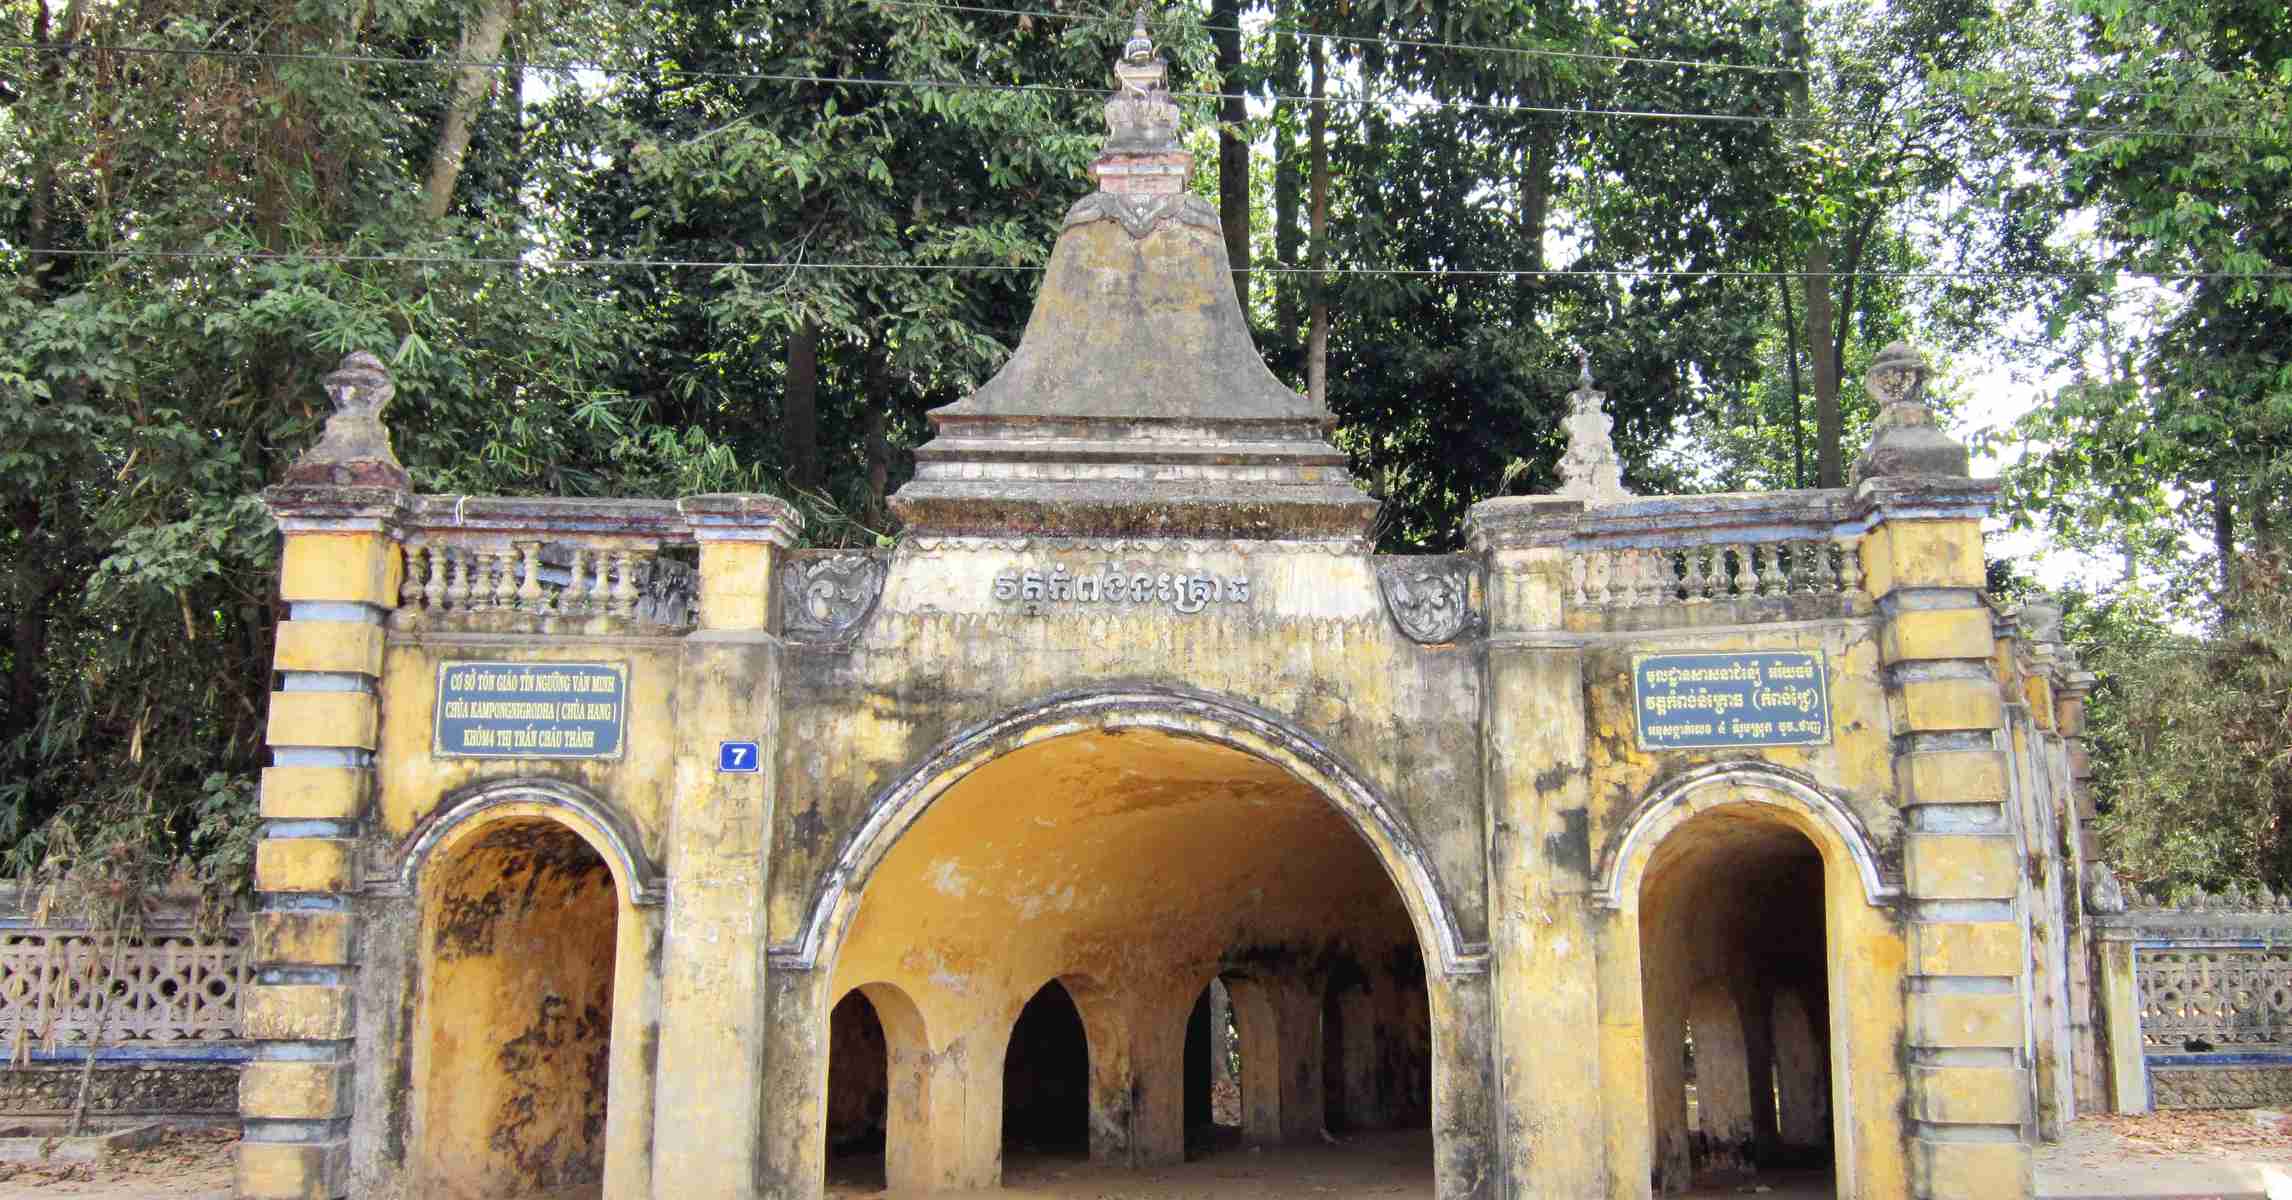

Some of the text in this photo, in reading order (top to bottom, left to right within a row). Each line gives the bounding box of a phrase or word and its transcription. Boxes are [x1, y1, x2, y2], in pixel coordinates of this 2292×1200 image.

[450, 668, 615, 692] CƠ SỞ TÔN GIÁO TÍN NGƯỠNG VĂN MINH
[446, 697, 469, 719] CHÙA
[496, 730, 512, 750] THỊ
[513, 723, 537, 747] TRẤN
[539, 725, 562, 748] CHÂU
[564, 726, 595, 748] THÀNH
[731, 748, 747, 766] 7
